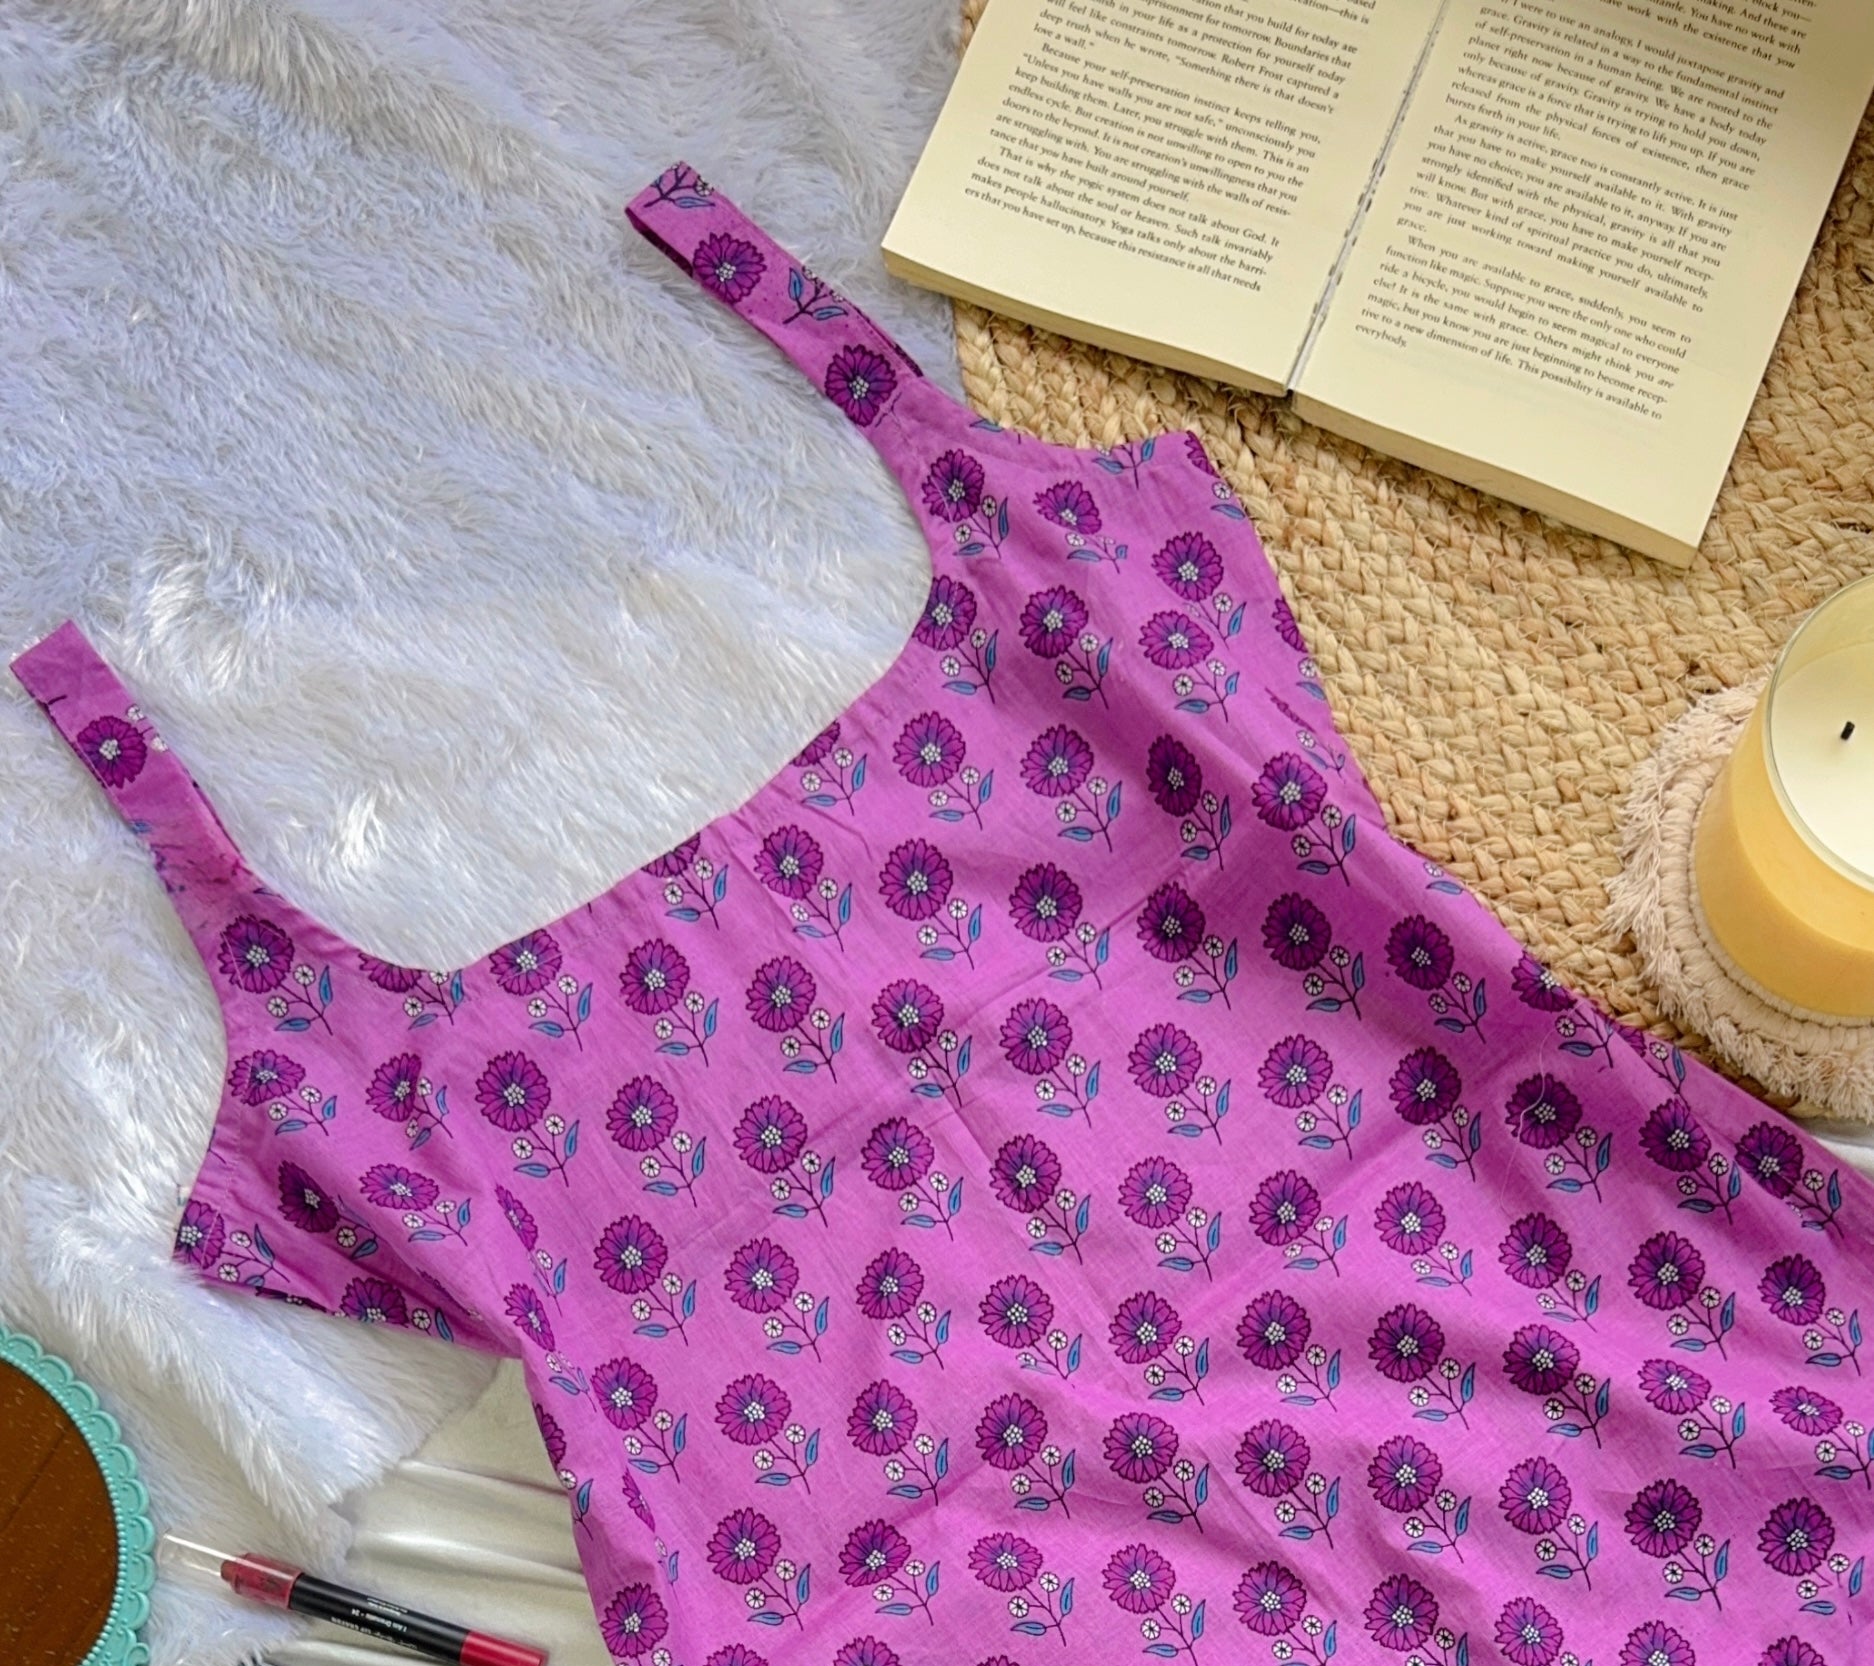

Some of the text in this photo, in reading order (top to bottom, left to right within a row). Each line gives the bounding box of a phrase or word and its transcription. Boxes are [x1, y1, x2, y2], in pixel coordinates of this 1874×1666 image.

[1041, 42, 1081, 64] Because
[1083, 59, 1107, 73] your
[1109, 69, 1191, 102] self-preservation
[1193, 96, 1231, 115] instinct
[1233, 106, 1262, 124] keeps
[1264, 119, 1297, 137] telling
[1119, 2, 1346, 86] in your life as a protection for yourself today
[1474, 20, 1489, 30] of
[1489, 25, 1571, 59] self-preservation
[1573, 52, 1585, 63] in
[1586, 58, 1594, 66] a
[1596, 58, 1632, 80] human
[1670, 84, 1685, 98] We
[1687, 93, 1704, 105] are
[1706, 100, 1741, 118] rooted
[1741, 112, 1754, 123] to
[1755, 116, 1774, 130] the
[1626, 4, 1796, 69] work with the existence that you
[1008, 84, 1044, 102] endless
[1074, 105, 1093, 119] But
[1093, 115, 1135, 134] creation
[1136, 128, 1146, 137] is
[1146, 132, 1165, 144] not
[1165, 138, 1213, 161] unwilling
[1214, 153, 1226, 163] to
[1226, 158, 1253, 171] open
[1253, 165, 1265, 175] to
[1265, 170, 1286, 182] you
[1287, 175, 1305, 188] the
[1014, 65, 1039, 84] keep
[1039, 74, 1082, 100] building
[1142, 114, 1163, 126] you
[1164, 121, 1204, 140] struggle
[1206, 134, 1229, 147] with
[1263, 149, 1285, 165] This
[1285, 158, 1295, 169] is
[1296, 164, 1310, 173] an
[1451, 80, 1493, 100] released
[1495, 92, 1521, 109] from
[1525, 103, 1542, 116] the
[1544, 111, 1589, 133] physical
[1591, 125, 1622, 145] forces
[1624, 140, 1639, 150] of
[1695, 164, 1718, 180] then
[1720, 175, 1750, 191] grace
[977, 156, 1001, 172] does
[1002, 167, 1021, 179] not
[1022, 174, 1043, 187] talk
[1045, 182, 1076, 199] about
[1077, 192, 1095, 205] the
[1096, 200, 1120, 213] soul
[1119, 208, 1133, 218] or
[1174, 223, 1199, 239] Such
[1201, 233, 1222, 246] talk
[1223, 239, 1274, 263] invariably
[999, 145, 1024, 163] That
[1024, 157, 1034, 167] is
[1036, 162, 1058, 176] why
[1059, 168, 1077, 181] the
[1077, 176, 1105, 192] yogic
[1106, 186, 1141, 204] system
[1142, 196, 1167, 212] does
[1168, 206, 1187, 218] not
[1187, 212, 1208, 225] talk
[1210, 218, 1241, 235] about
[1270, 236, 1280, 247] It
[1421, 156, 1463, 176] strongly
[1465, 169, 1515, 192] identified
[1516, 187, 1540, 201] with
[1543, 195, 1560, 208] the
[1609, 221, 1646, 241] gravity
[1648, 232, 1658, 244] is
[1660, 238, 1676, 250] all
[1677, 244, 1699, 259] that
[1701, 254, 1721, 268] you
[1433, 124, 1455, 138] that
[1456, 133, 1477, 145] you
[1479, 137, 1503, 154] have
[1505, 148, 1517, 159] to
[1519, 154, 1548, 169] make
[1549, 164, 1592, 185] yourself
[1593, 180, 1638, 201] available
[1640, 196, 1652, 207] to
[1671, 205, 1695, 222] With
[1696, 218, 1733, 237] gravity
[1407, 234, 1436, 253] When
[1438, 248, 1459, 260] you
[1462, 256, 1479, 267] are
[1481, 263, 1526, 283] available
[1529, 278, 1541, 288] to
[1628, 314, 1648, 328] you
[1651, 323, 1677, 338] seem
[1680, 334, 1692, 344] to
